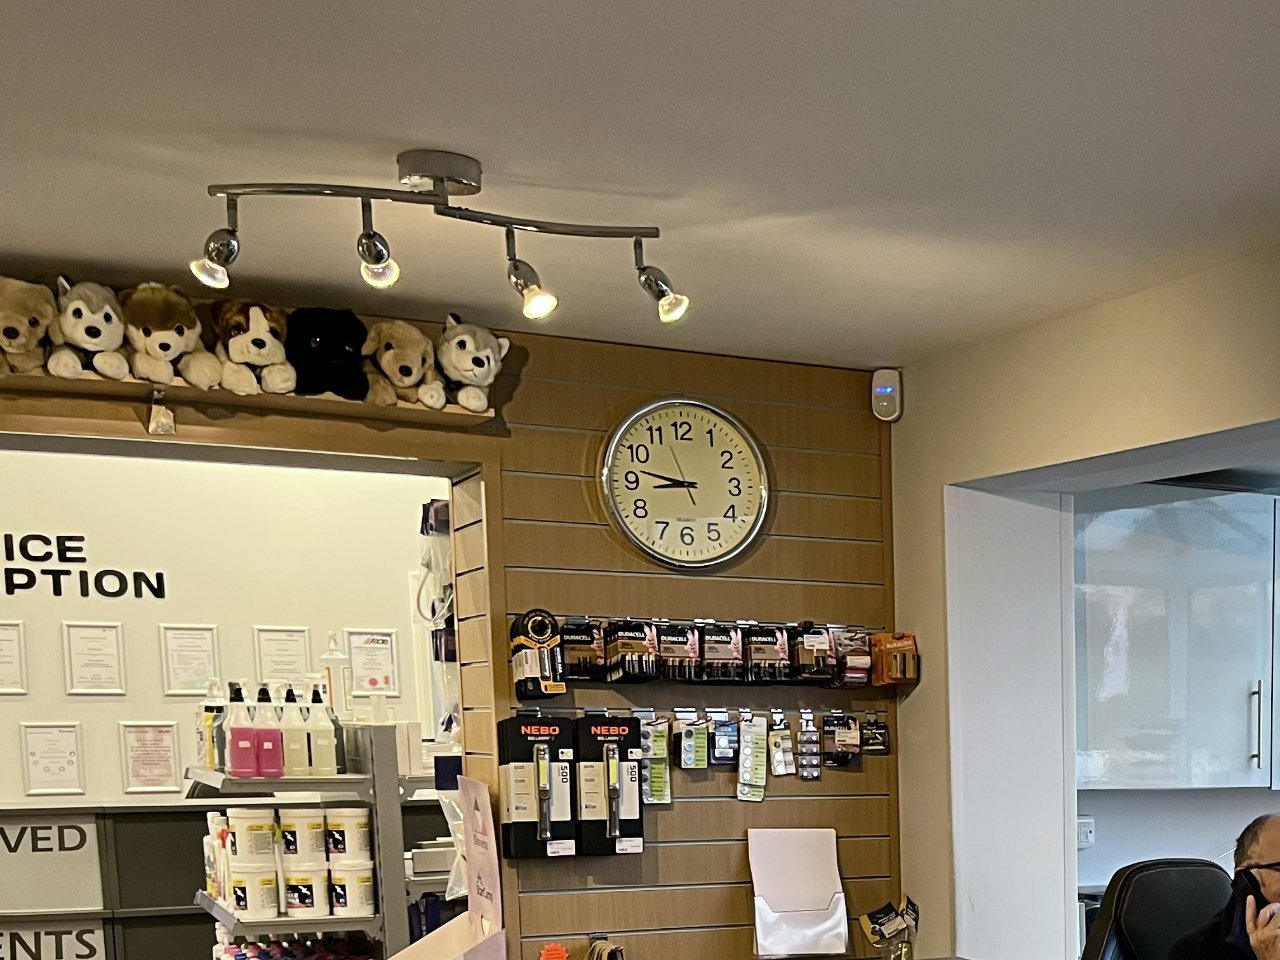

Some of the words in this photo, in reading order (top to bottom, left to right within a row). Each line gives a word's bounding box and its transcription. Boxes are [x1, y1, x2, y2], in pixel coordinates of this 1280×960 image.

[646, 425, 663, 445] 11
[670, 421, 693, 441] 12
[706, 428, 714, 447] 1
[627, 444, 650, 463] 10
[720, 450, 734, 469] 2
[624, 470, 640, 491] 9
[728, 477, 742, 497] 3
[633, 498, 648, 519] 8
[722, 504, 738, 523] 4
[655, 521, 670, 540] 7
[680, 526, 694, 546] 6
[707, 522, 721, 541] 5
[4, 534, 87, 563] ICE
[4, 568, 166, 599] PTION
[521, 726, 560, 735] NEBO
[591, 726, 629, 735] NEBO
[560, 766, 569, 783] 500
[629, 765, 637, 783] 500
[0, 825, 87, 853] VED
[0, 929, 98, 960] NTS
